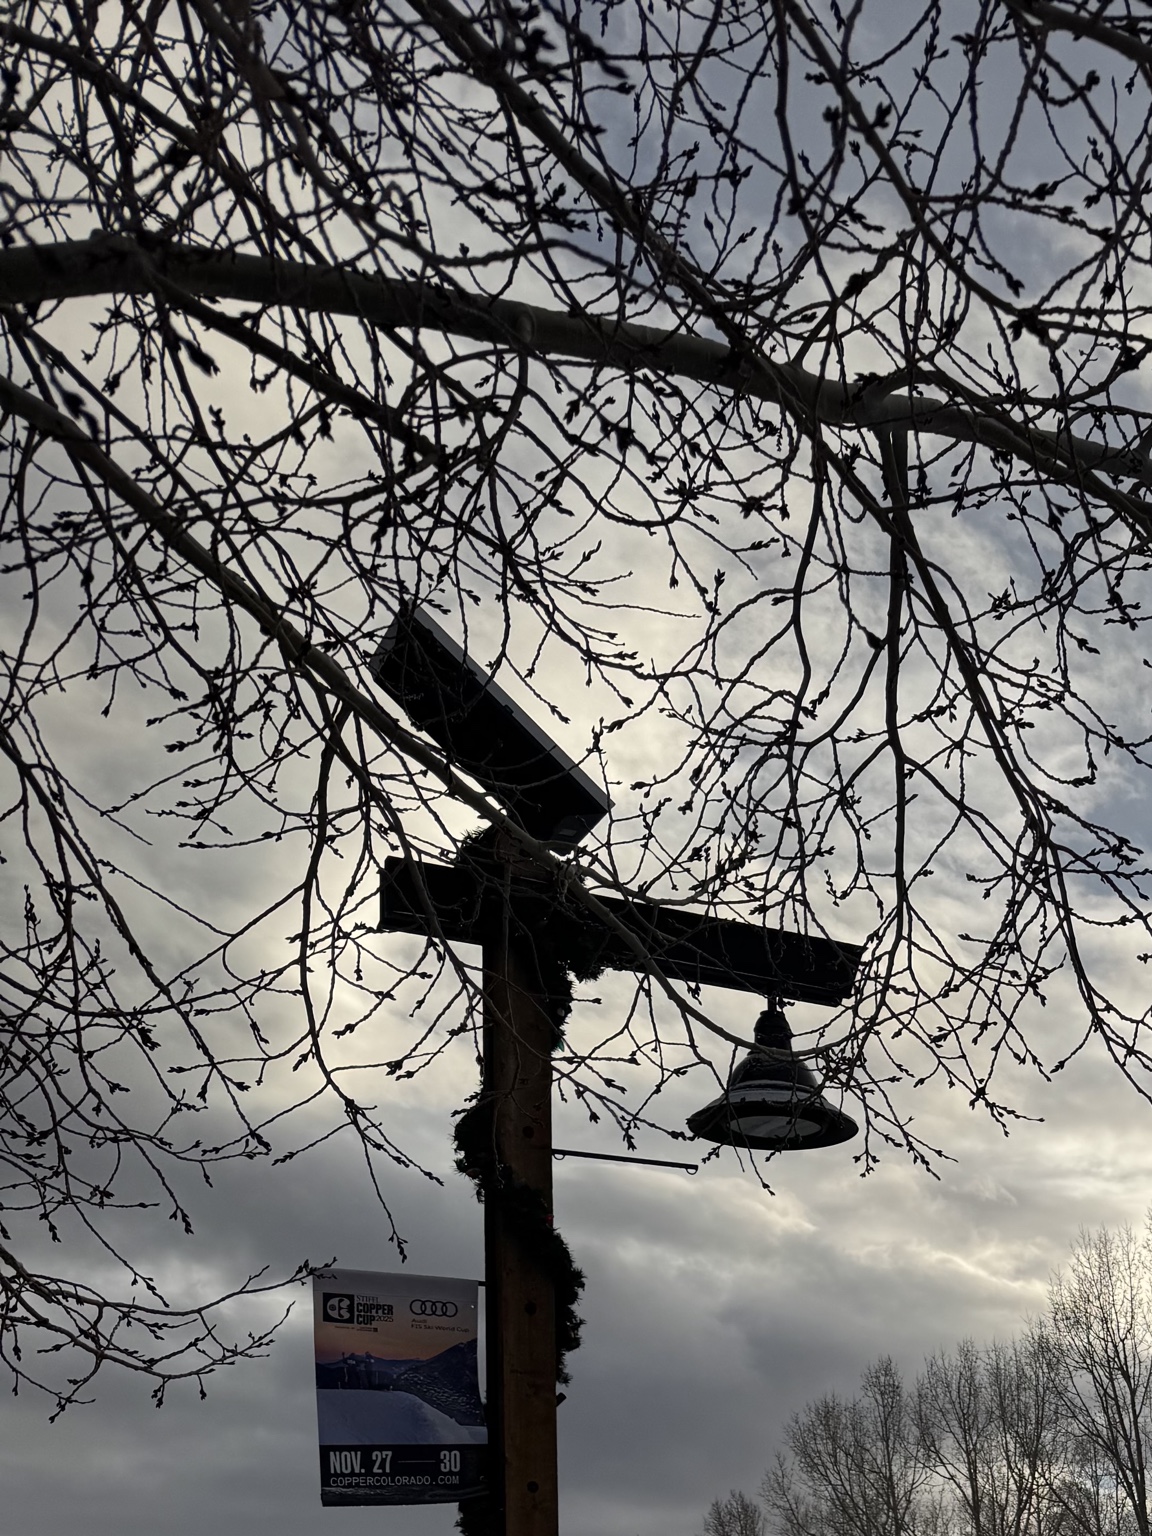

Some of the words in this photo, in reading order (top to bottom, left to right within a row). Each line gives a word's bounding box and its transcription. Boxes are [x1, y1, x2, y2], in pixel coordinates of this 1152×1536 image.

[356, 1302, 394, 1316] COPPER
[356, 1314, 375, 1326] CUP
[375, 1315, 394, 1323] 2025
[329, 1450, 365, 1474] NOV.
[371, 1450, 393, 1473] 27
[439, 1450, 461, 1473] 30
[330, 1475, 460, 1487] COPPERCOLORADO.COM
